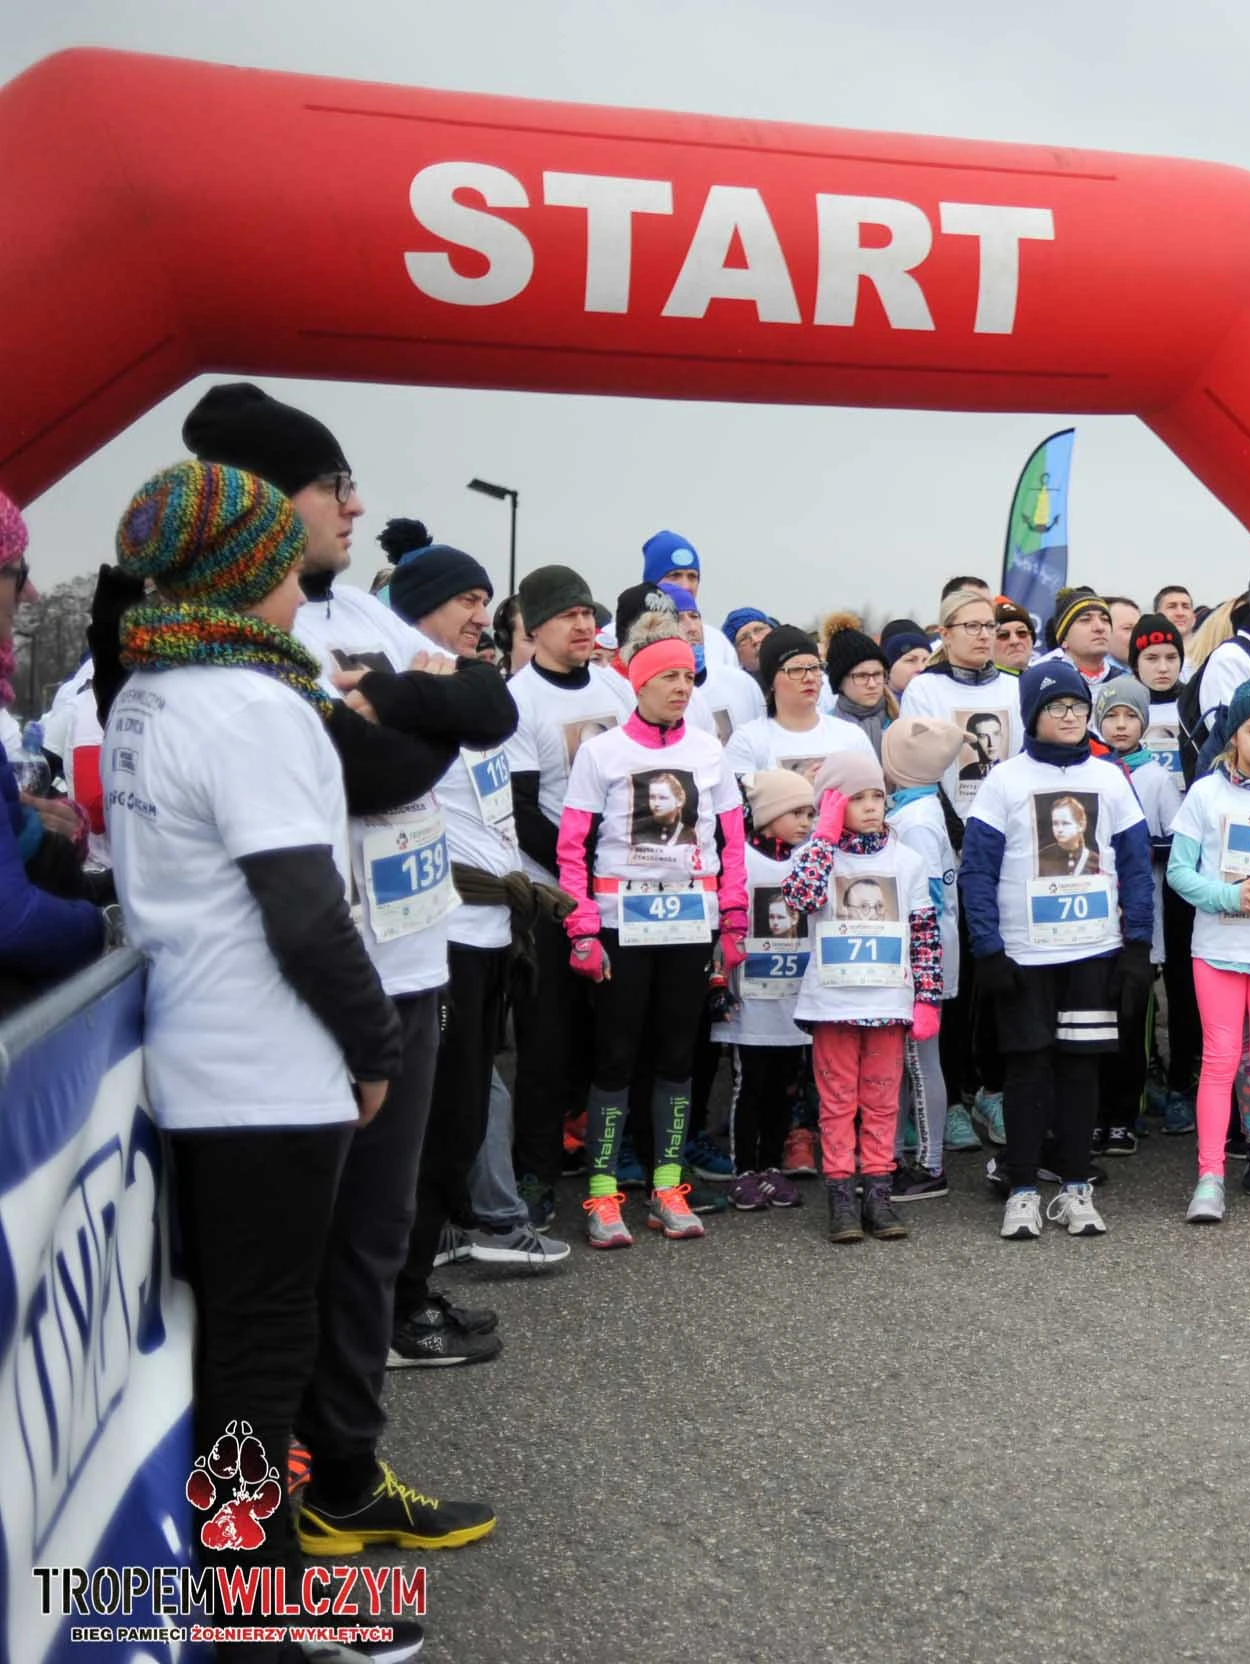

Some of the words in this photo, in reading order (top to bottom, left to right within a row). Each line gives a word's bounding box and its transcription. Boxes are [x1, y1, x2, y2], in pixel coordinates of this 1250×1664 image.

[404, 161, 1055, 336] START
[402, 843, 444, 891] 139
[649, 895, 681, 919] 49
[1058, 896, 1088, 920] 70
[770, 955, 798, 977] 25
[848, 938, 877, 961] 71
[593, 1106, 623, 1169] Kalenji
[664, 1096, 689, 1159] Kalenji
